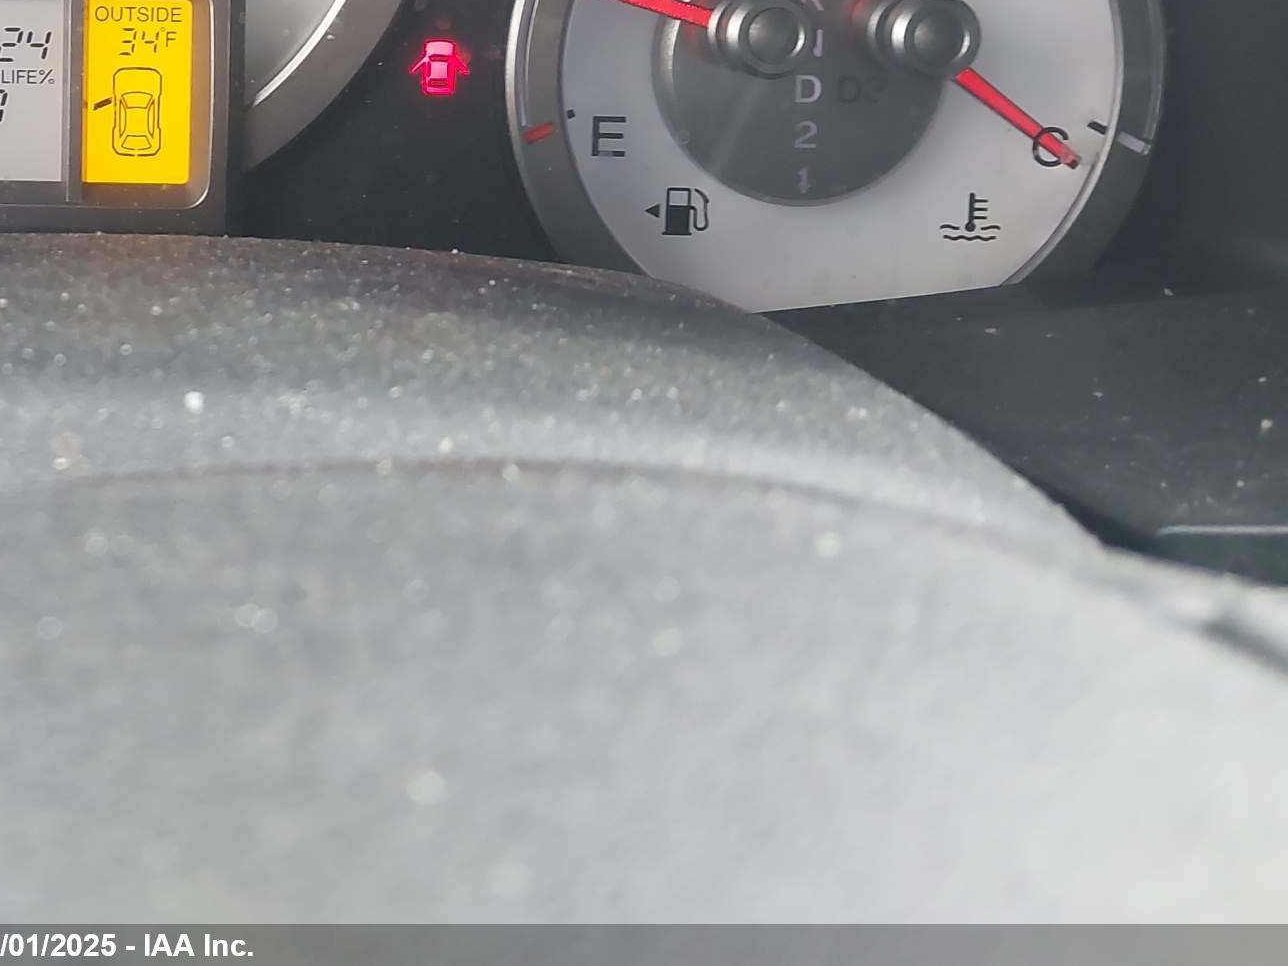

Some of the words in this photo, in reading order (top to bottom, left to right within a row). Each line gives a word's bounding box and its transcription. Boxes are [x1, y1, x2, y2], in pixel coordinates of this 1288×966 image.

[95, 6, 182, 22] OUTSIDE
[2, 69, 54, 84] LIFE%
[795, 75, 822, 103] D
[592, 116, 626, 157] E
[794, 121, 817, 148] 2
[1032, 127, 1069, 167] C
